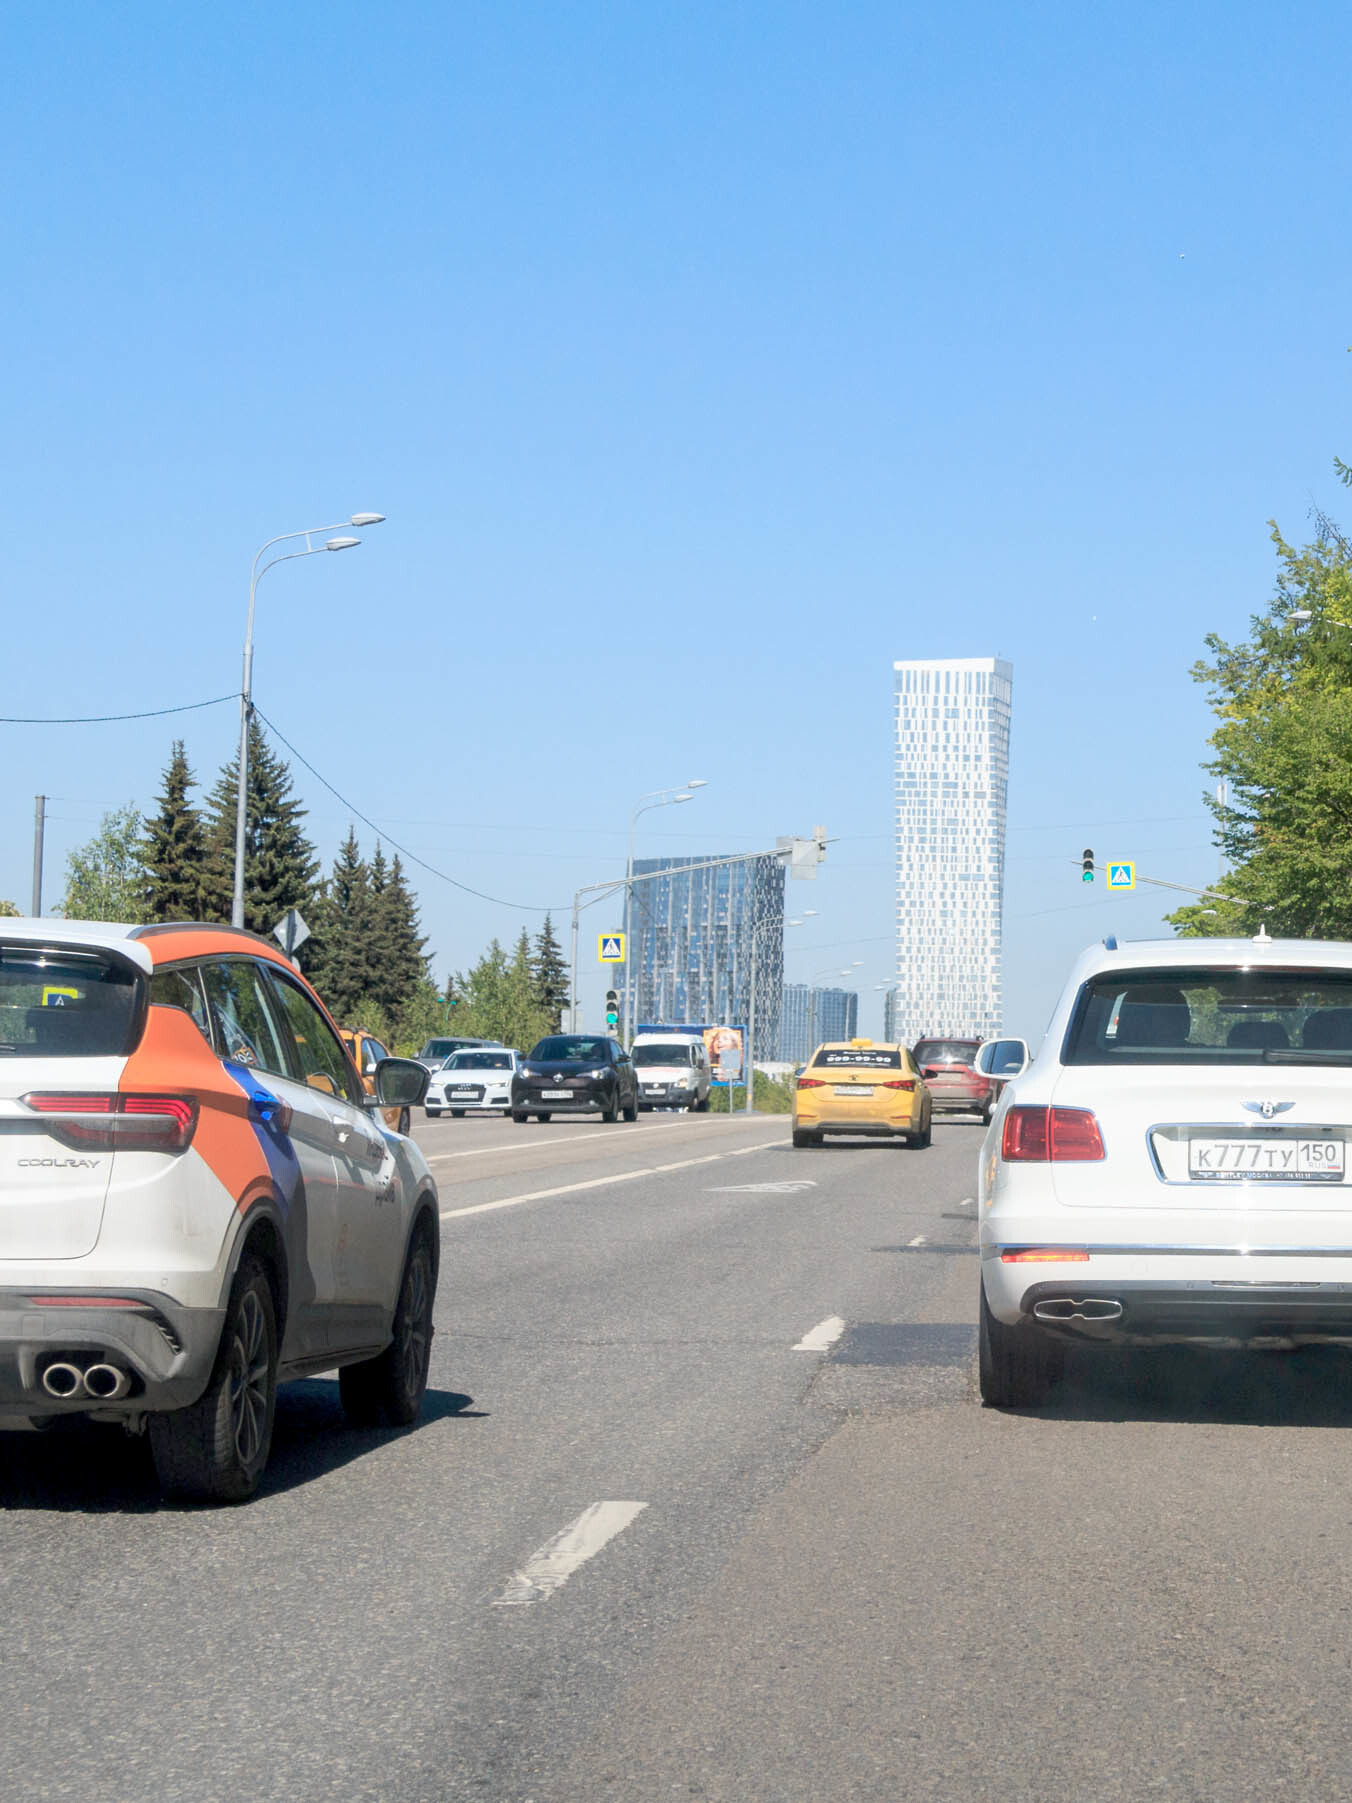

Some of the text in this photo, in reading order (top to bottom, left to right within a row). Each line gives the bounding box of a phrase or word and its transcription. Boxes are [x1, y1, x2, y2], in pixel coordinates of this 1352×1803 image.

[17, 1158, 101, 1168] COOLRAY
[1198, 1143, 1337, 1168] К777ТУ 150
